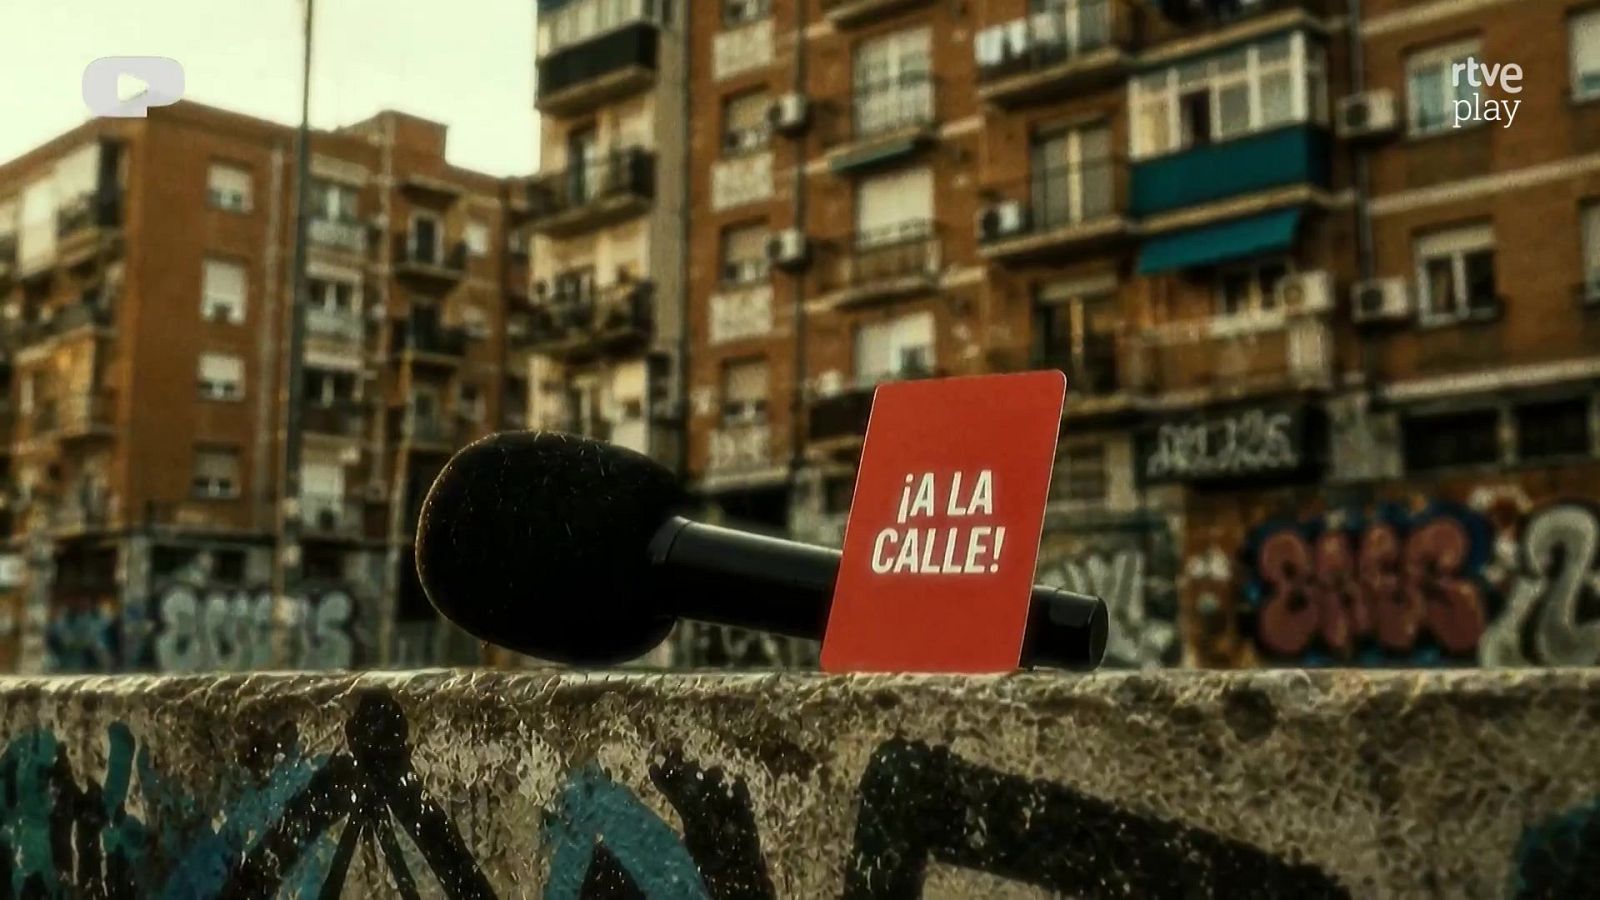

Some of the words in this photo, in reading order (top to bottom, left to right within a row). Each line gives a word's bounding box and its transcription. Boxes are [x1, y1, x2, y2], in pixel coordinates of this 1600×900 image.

[897, 473, 935, 523] ¡A
[947, 469, 993, 516] LA
[871, 526, 1006, 574] CALLE!
